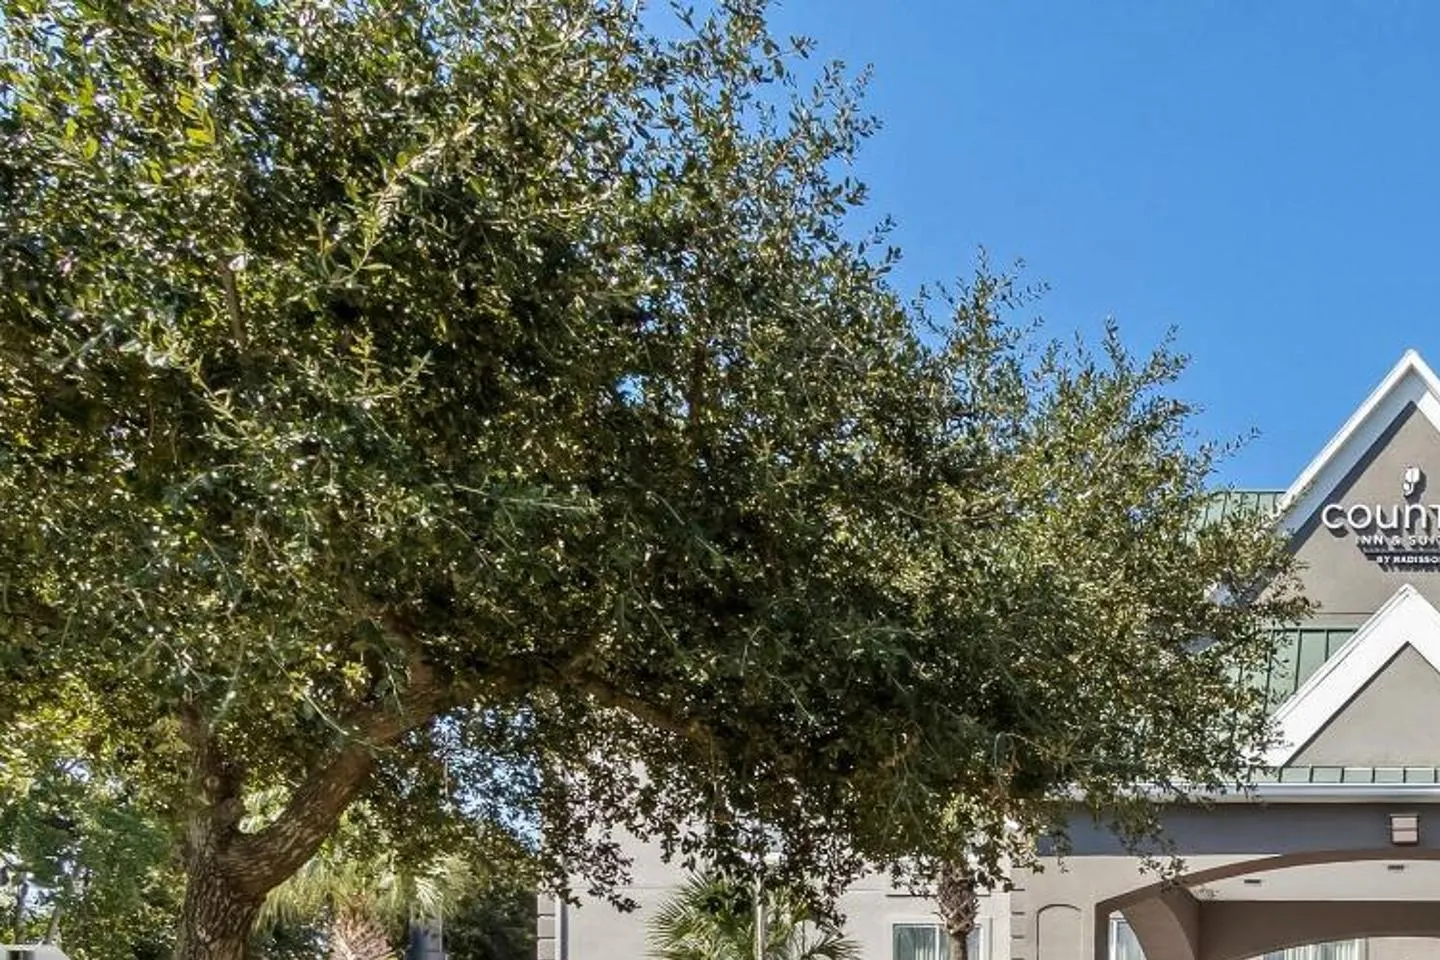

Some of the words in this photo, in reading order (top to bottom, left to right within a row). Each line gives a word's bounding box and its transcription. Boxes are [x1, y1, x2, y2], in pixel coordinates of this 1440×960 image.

[1355, 534, 1384, 546] INN
[1391, 534, 1401, 546] &
[1376, 555, 1390, 564] BY
